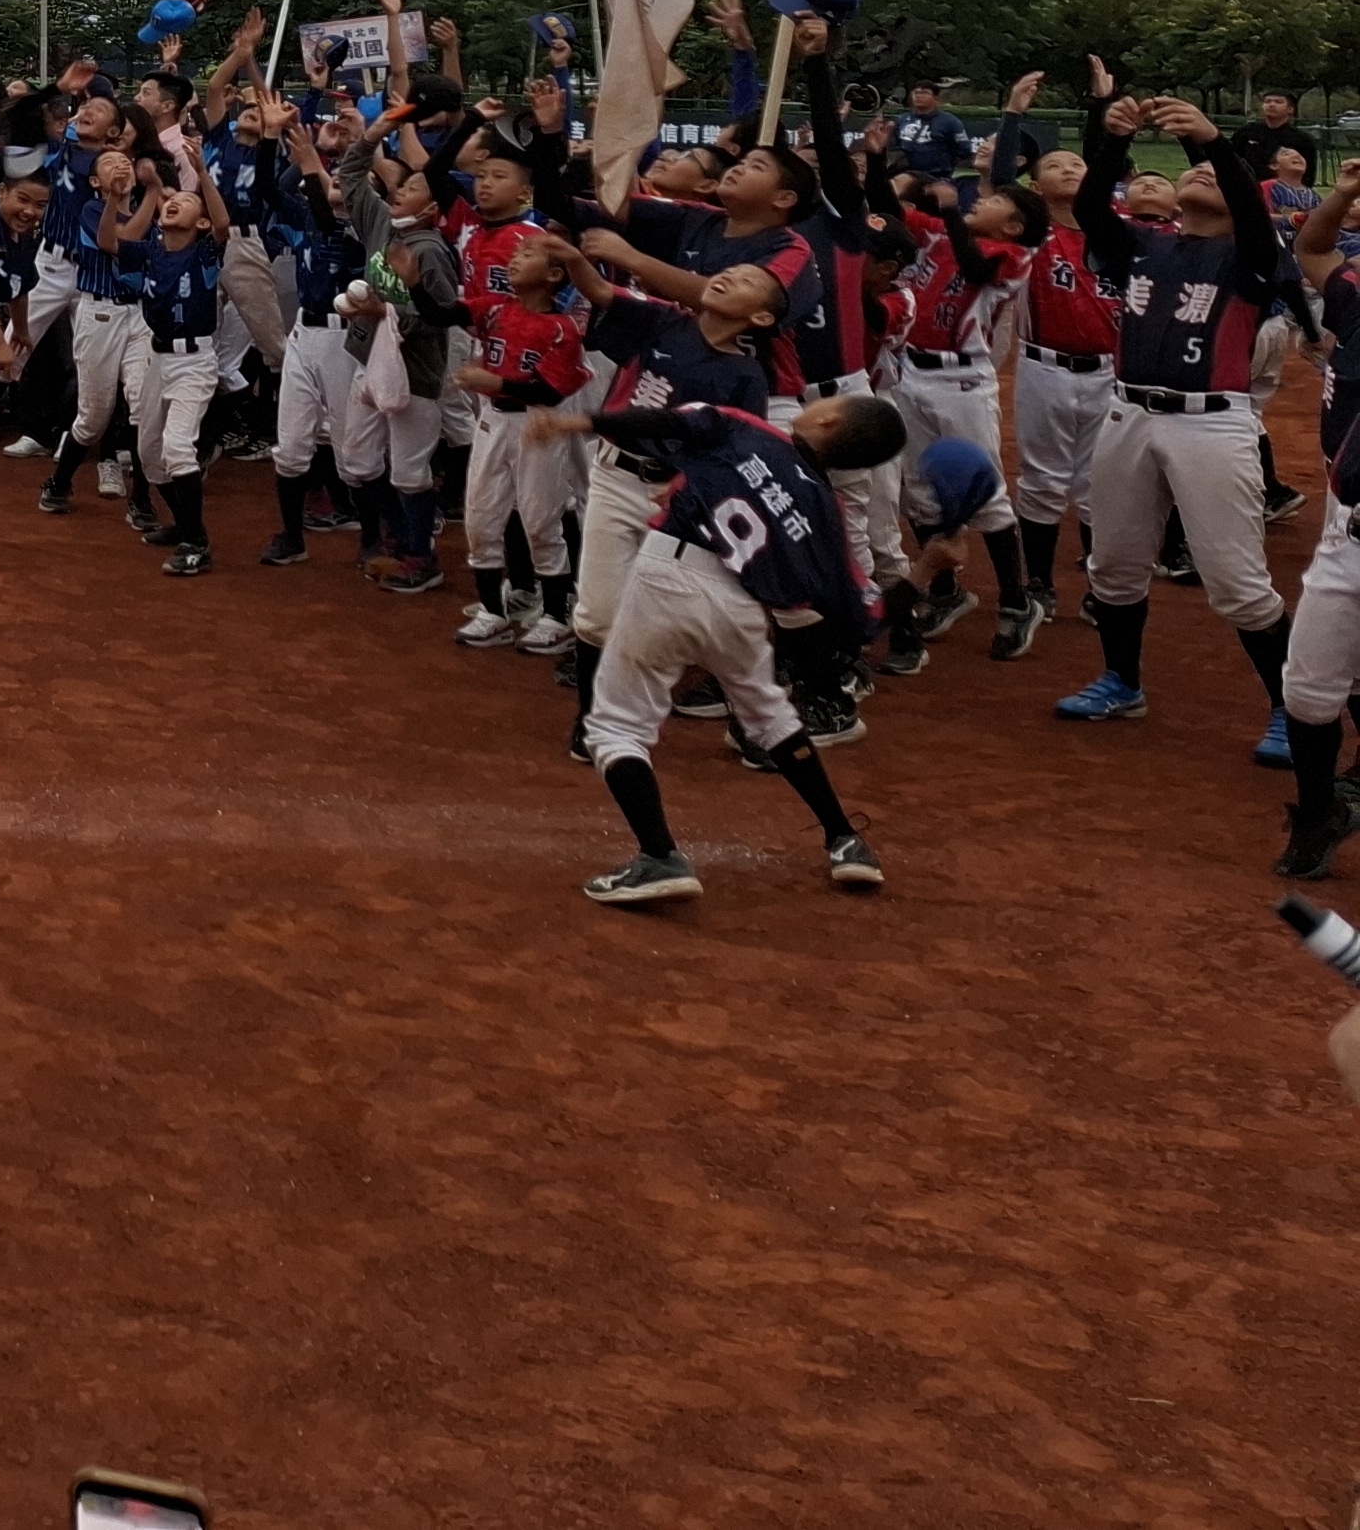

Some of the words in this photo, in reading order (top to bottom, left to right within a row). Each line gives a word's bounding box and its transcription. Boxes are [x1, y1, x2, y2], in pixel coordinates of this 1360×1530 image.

[342, 26, 379, 38] 新北市
[1182, 337, 1204, 364] 5
[735, 452, 813, 542] 高雄市
[699, 497, 768, 574] 9
